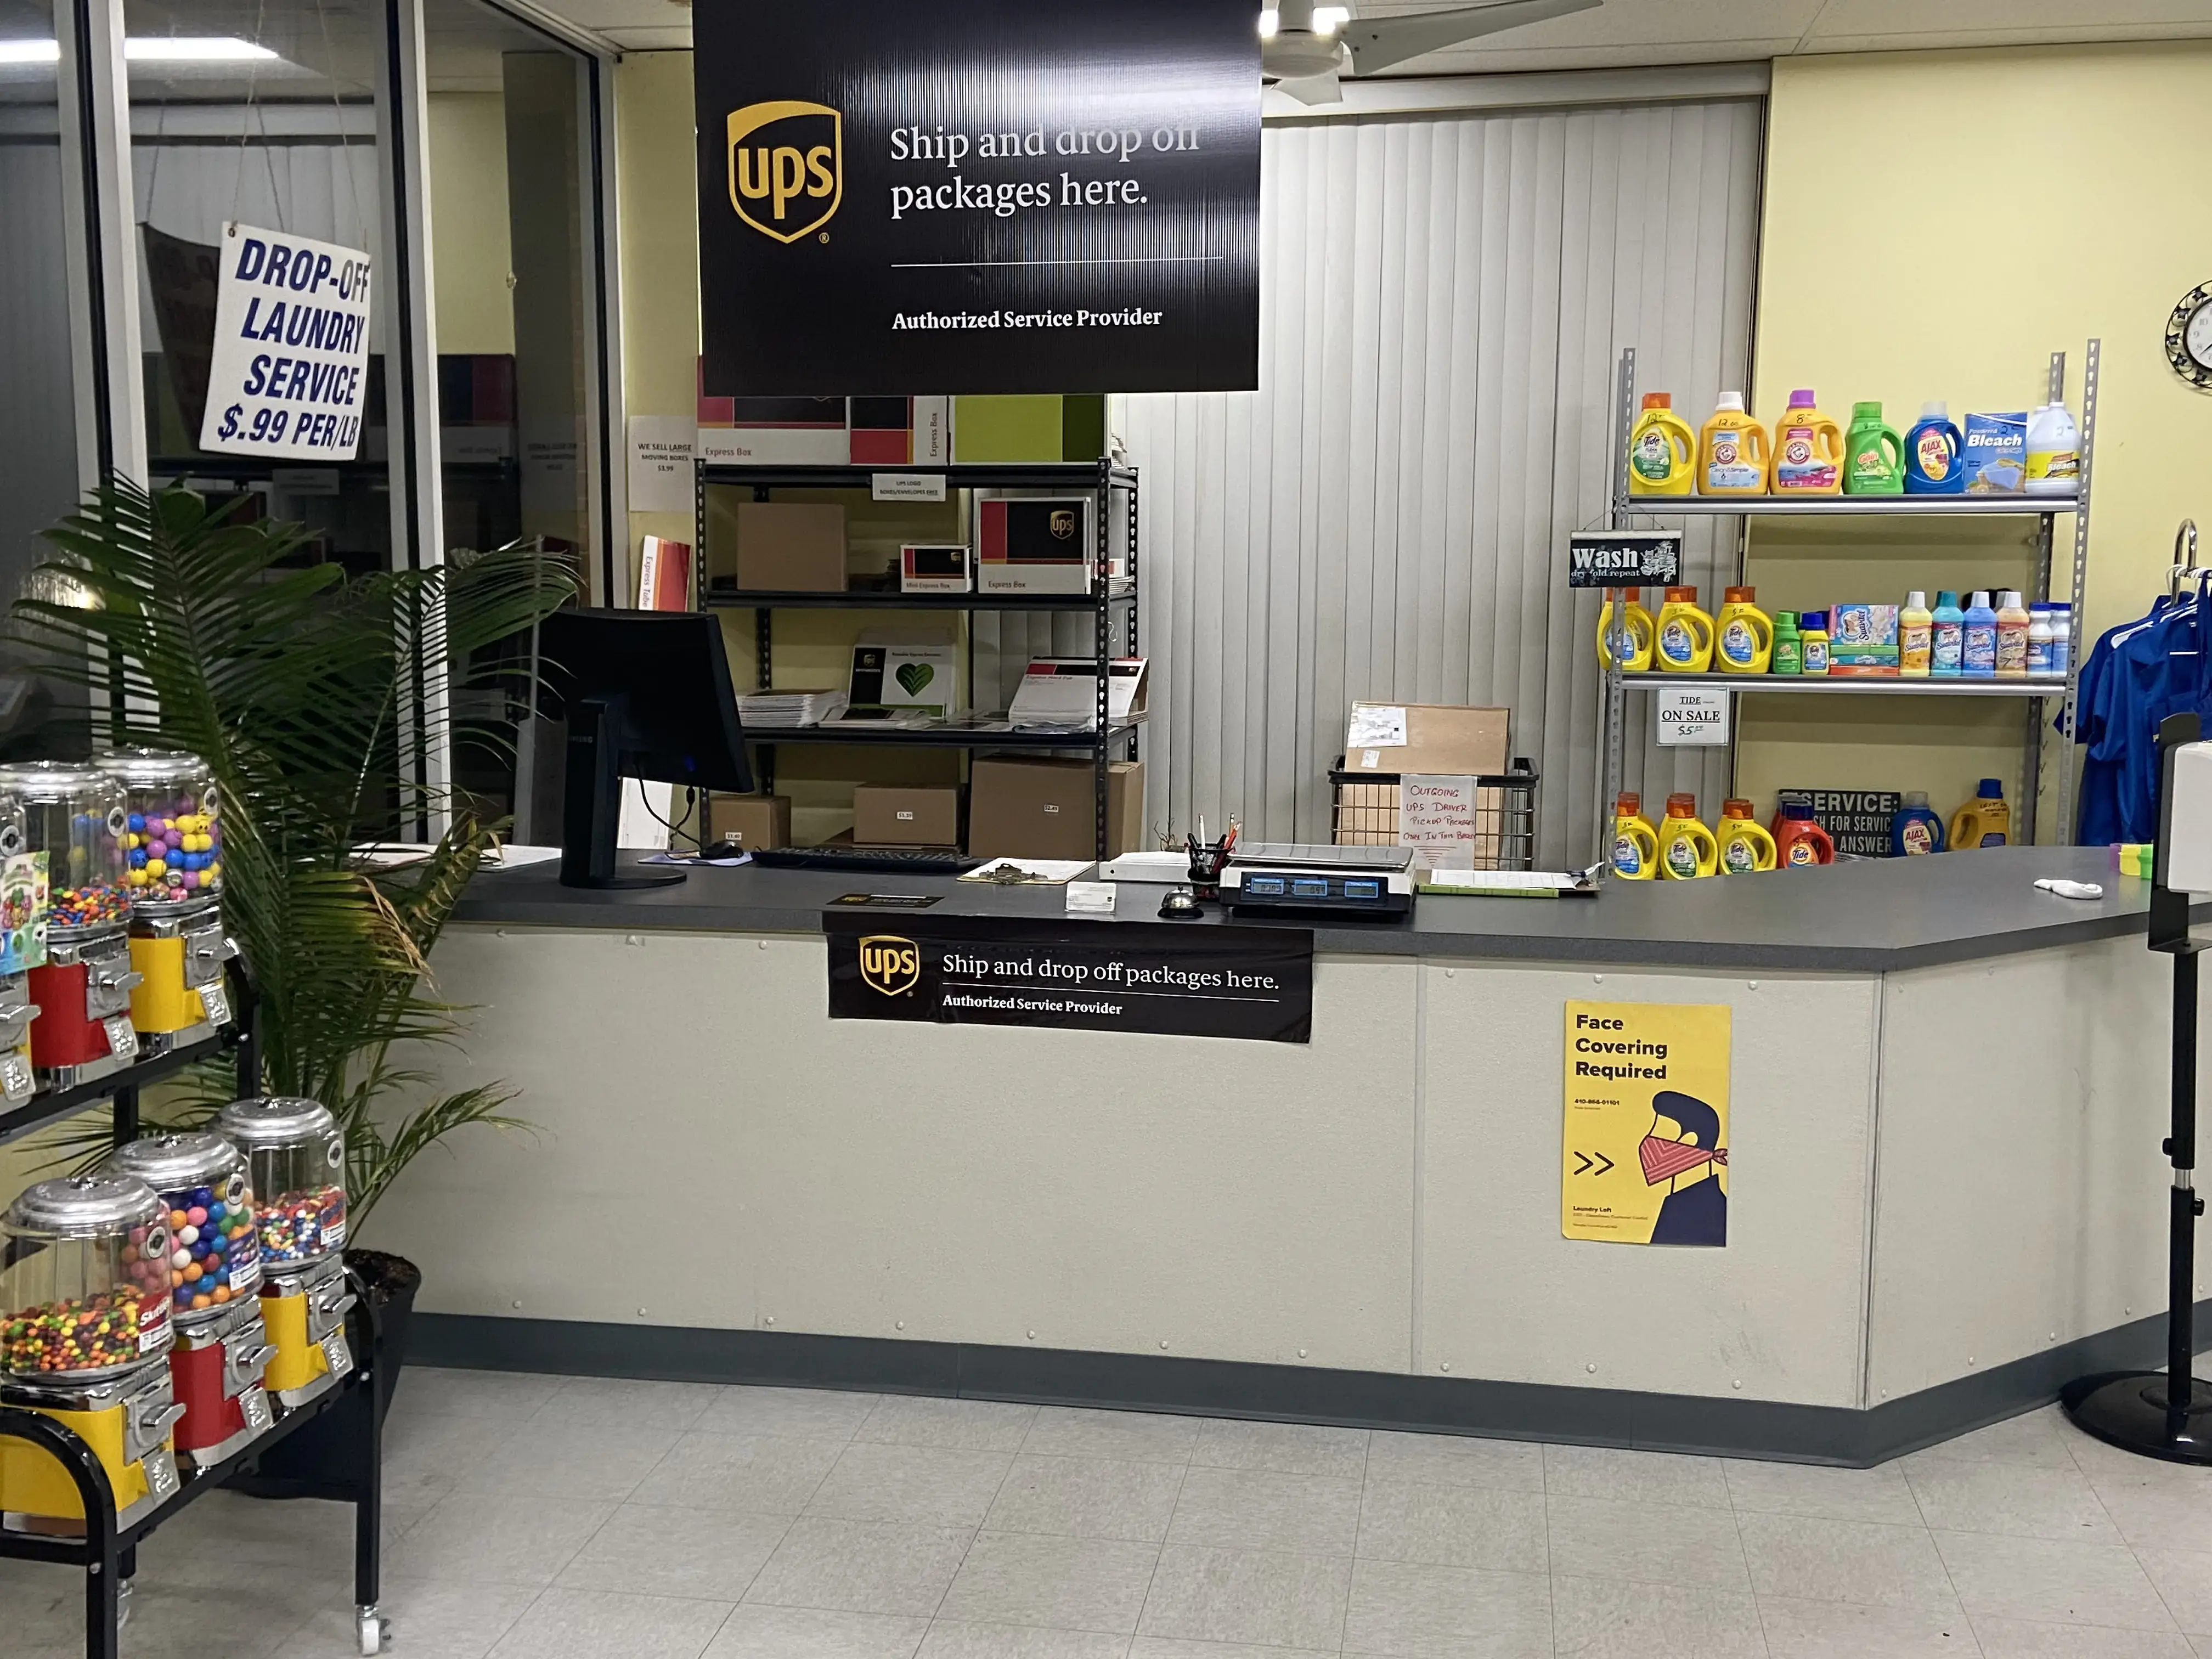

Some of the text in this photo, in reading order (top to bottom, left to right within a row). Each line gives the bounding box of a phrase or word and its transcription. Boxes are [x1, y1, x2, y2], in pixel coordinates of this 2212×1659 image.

[890, 127, 969, 168] Ship
[978, 123, 1047, 159] and
[1056, 123, 1142, 163] drop
[737, 145, 834, 220] ups
[890, 172, 1148, 219] packages here.
[235, 238, 370, 303] DROP-OFF
[240, 297, 365, 354] LAUNDRY
[891, 308, 1163, 330] Authorized Service Provider
[243, 354, 360, 405] SERVICE
[218, 403, 359, 450] $.99 PER/LB
[929, 429, 939, 457] Express
[1921, 439, 1941, 454] AJAX
[1967, 433, 2022, 447] Bleach
[706, 447, 752, 458] Express Box
[2047, 461, 2076, 471] Bleach
[1052, 518, 1073, 532] ups
[1572, 548, 1638, 568] Wash
[644, 556, 653, 585] Express
[1610, 570, 1640, 578] repeat
[988, 580, 1012, 589] Express
[1662, 710, 1720, 721] ON SALE
[1410, 785, 1459, 798] OUTGOING
[1406, 802, 1468, 813] UPS DRIVER
[1409, 816, 1442, 826] PICKUP
[1830, 816, 1850, 831] FOR
[1854, 816, 1892, 832] SERVIC
[1425, 831, 1437, 840] IN
[1906, 828, 1925, 842] AJAX
[1839, 836, 1892, 853] ANSWER
[1792, 849, 1809, 860] Tide
[865, 948, 915, 984] ups
[943, 954, 1279, 990] Ship and drop off packages here.
[943, 994, 1123, 1015] Authorized Service Provider
[1576, 1014, 1624, 1030] Face
[1575, 1037, 1668, 1059] Covering
[1576, 1061, 1667, 1081] Required
